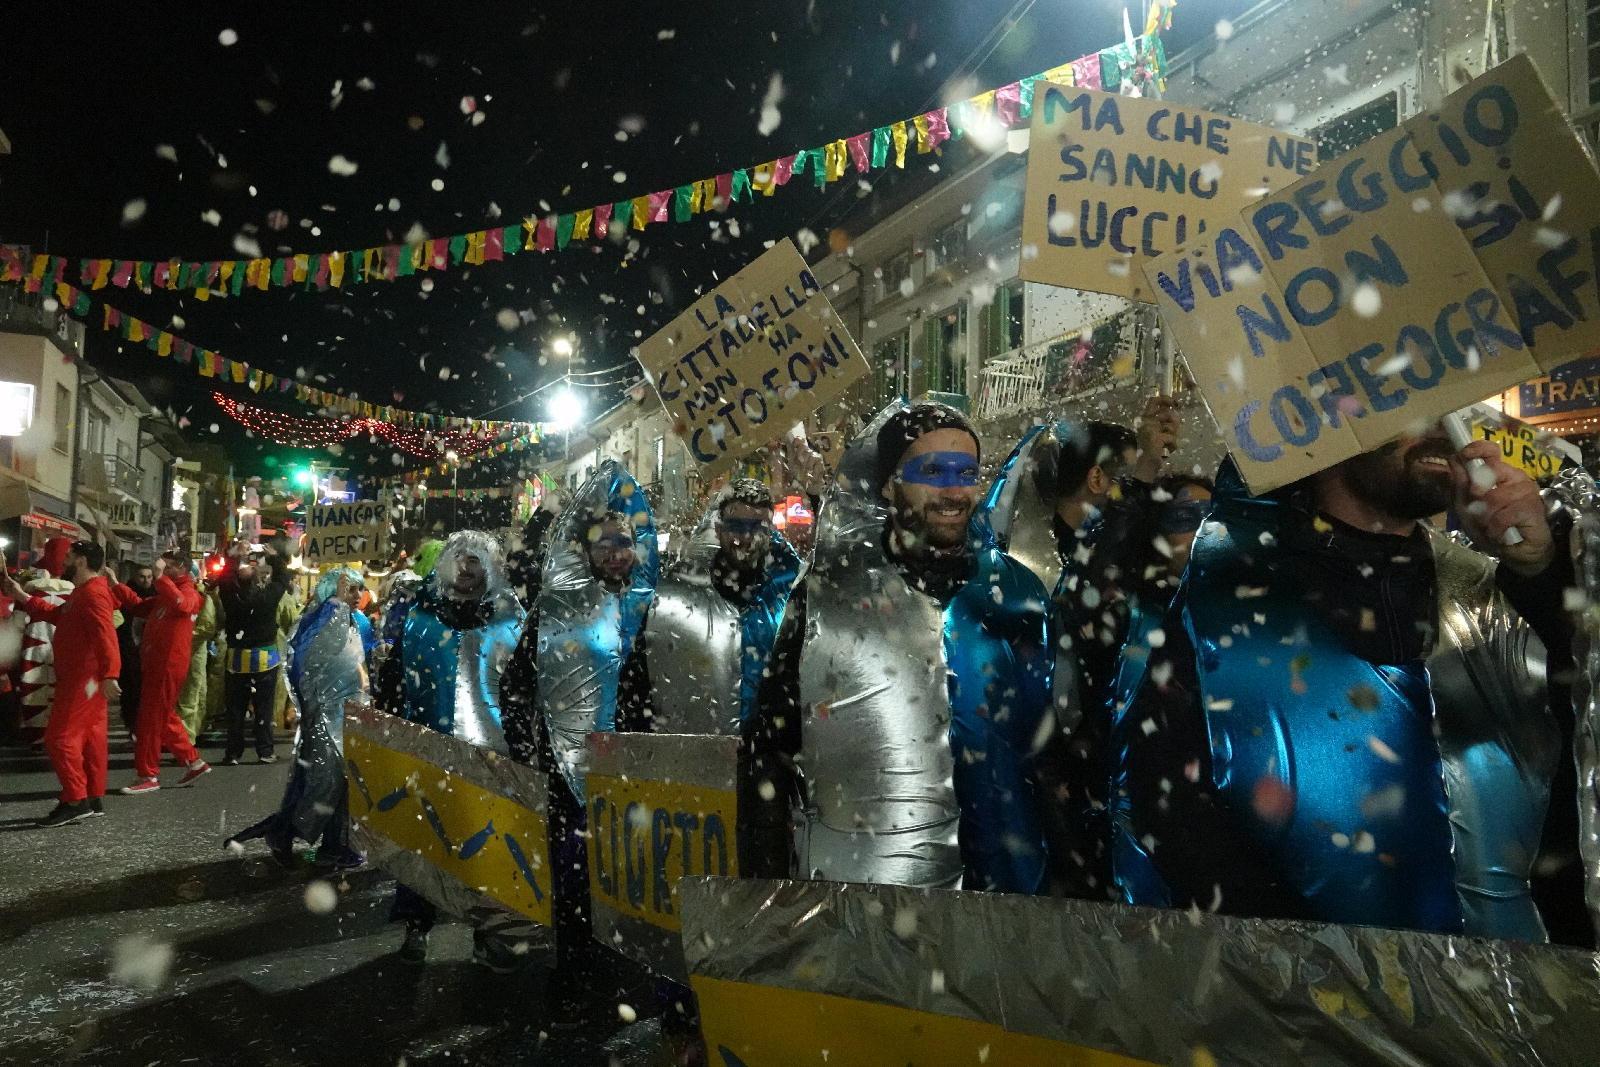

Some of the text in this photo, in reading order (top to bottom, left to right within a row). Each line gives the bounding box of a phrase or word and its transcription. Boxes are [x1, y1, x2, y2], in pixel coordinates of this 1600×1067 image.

[1043, 87, 1316, 176] MA CHE NE
[1058, 144, 1219, 199] SANNO
[1158, 84, 1519, 313] VIAREGGIO
[659, 269, 821, 402] CITTADELLA
[695, 293, 736, 331] LA
[1236, 234, 1409, 358] NON
[684, 323, 802, 421] NON HA
[1233, 228, 1600, 463] COREOGRAF
[691, 331, 850, 462] CITOFONI
[308, 532, 379, 558] APERTI
[311, 504, 386, 527] HANGAR
